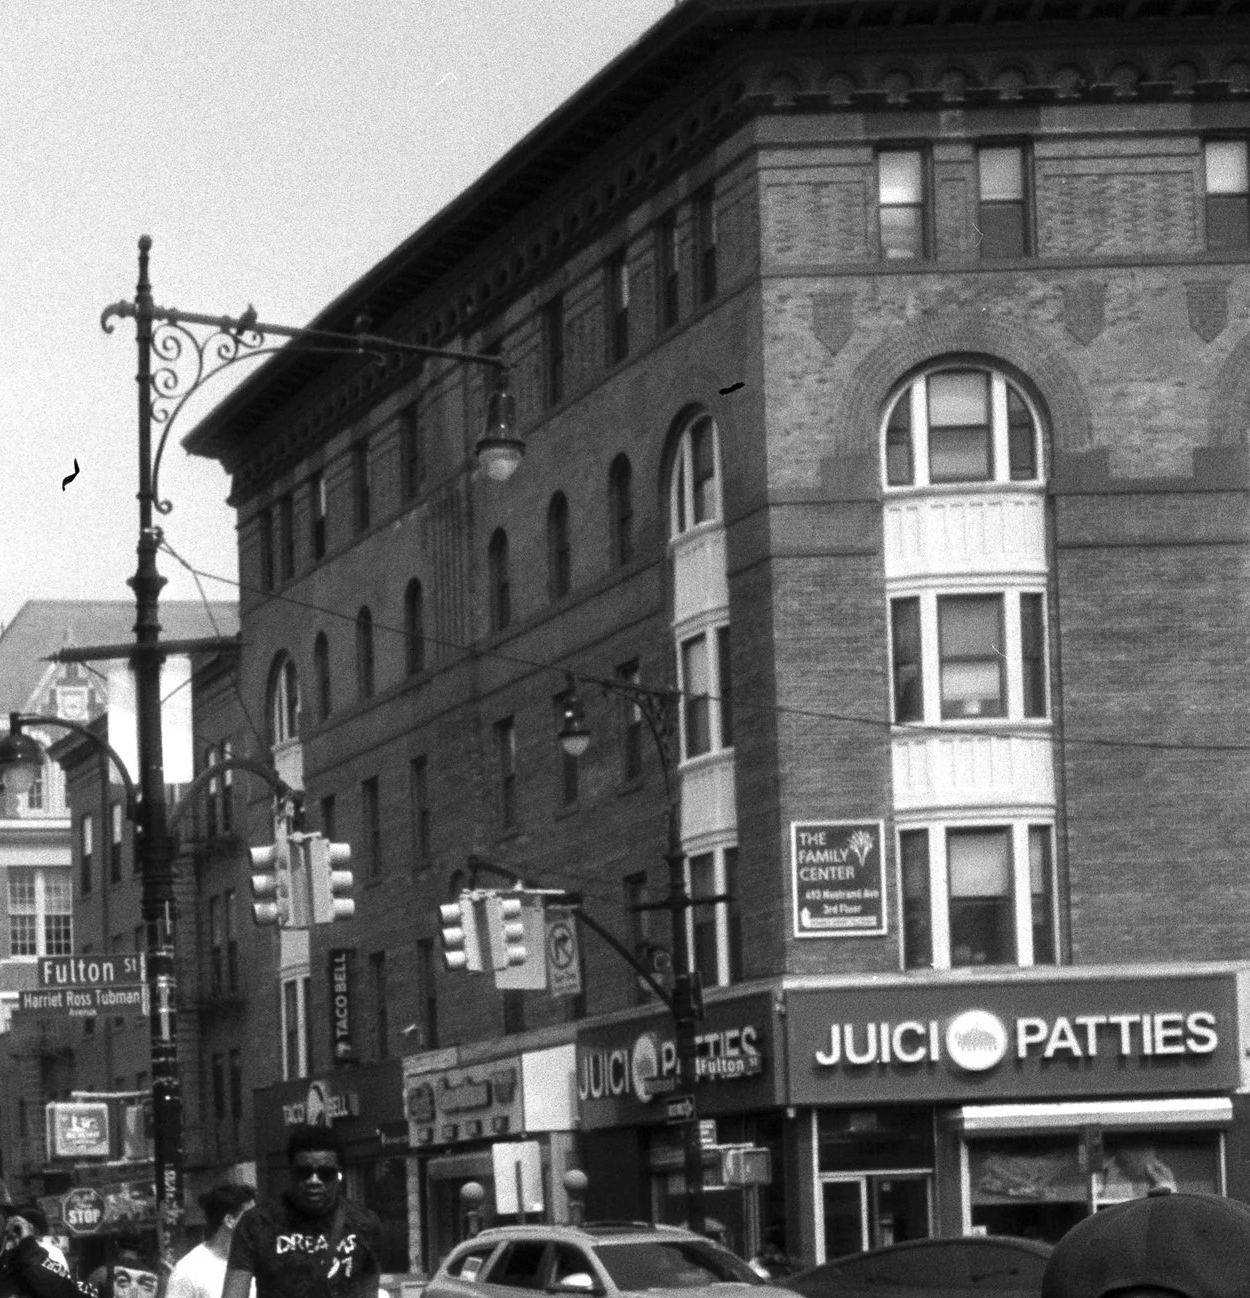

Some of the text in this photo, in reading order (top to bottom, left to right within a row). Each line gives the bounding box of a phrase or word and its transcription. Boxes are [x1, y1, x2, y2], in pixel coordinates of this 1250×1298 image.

[799, 831, 827, 846] THE
[798, 848, 849, 864] FAMILY
[799, 866, 855, 881] CENTER
[44, 957, 137, 984] Fulton St
[24, 989, 140, 1008] Harriet Ross Tubman
[333, 953, 348, 1039] TACO BELL
[815, 1018, 939, 1066] JUICI
[1016, 1011, 1219, 1058] PATTIES
[699, 1057, 745, 1074] Fulton
[579, 1050, 631, 1101] JUICI
[68, 1208, 101, 1225] STOP
